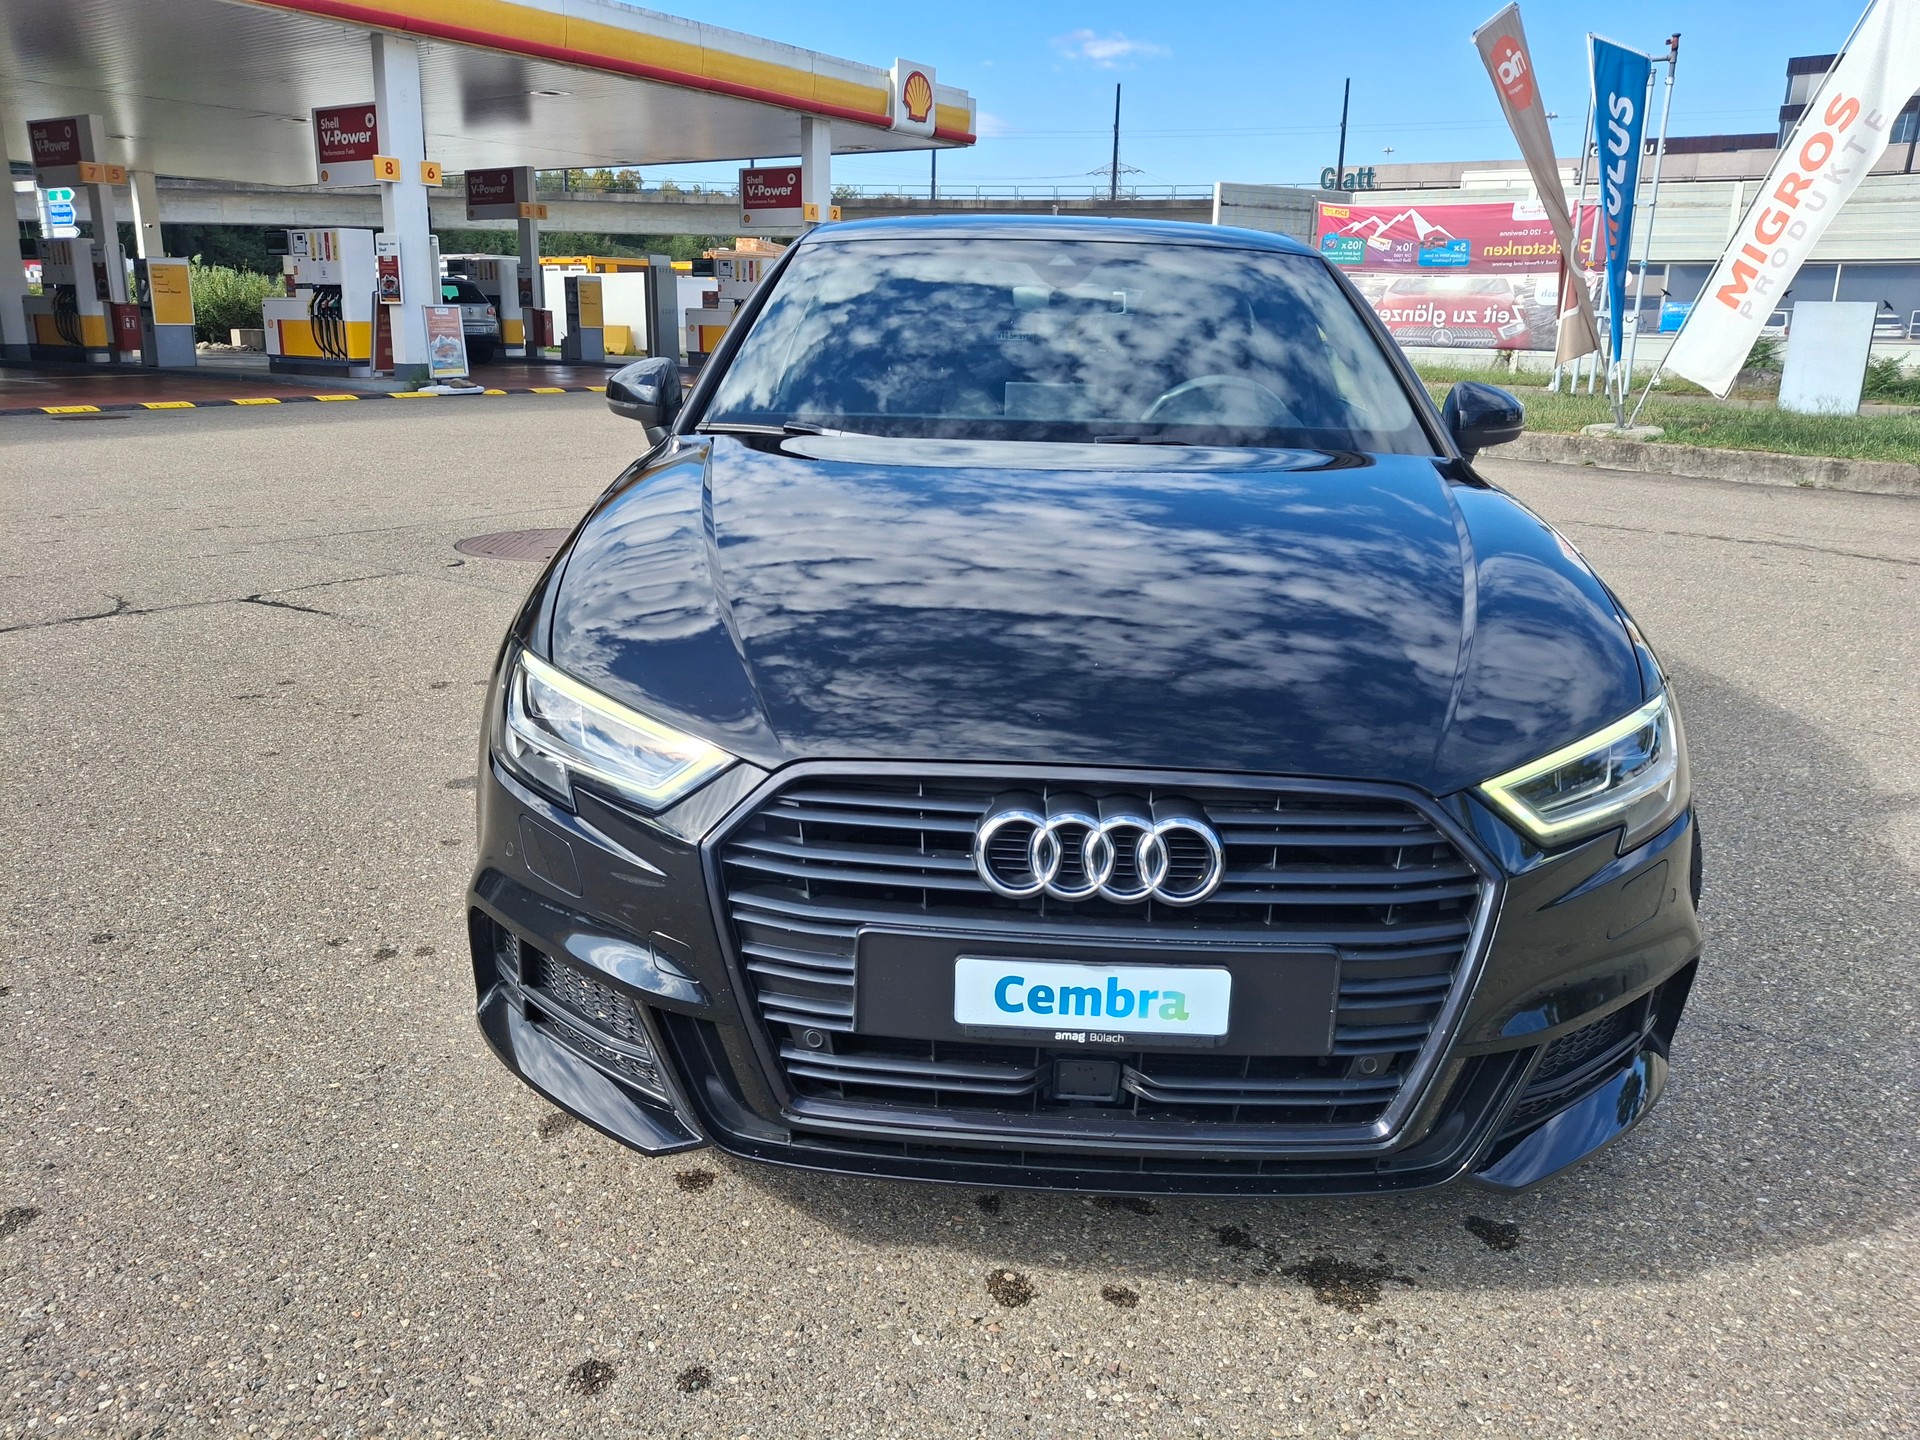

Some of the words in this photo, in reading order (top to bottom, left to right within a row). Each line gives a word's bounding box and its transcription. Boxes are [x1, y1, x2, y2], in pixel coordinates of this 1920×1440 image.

[320, 117, 339, 130] Shell
[33, 128, 47, 139] Shell
[321, 130, 372, 146] V-Power
[34, 139, 70, 153] V-Power
[87, 166, 96, 178] 7
[112, 168, 120, 180] 5
[385, 161, 394, 175] 8
[427, 167, 435, 179] 6
[746, 174, 764, 185] Shell
[1320, 166, 1376, 190] Gatt
[471, 184, 505, 195] V-Power
[746, 184, 793, 197] V-Power
[1715, 92, 1861, 310] MIGROS
[525, 206, 531, 215] 3
[538, 207, 543, 216] 1
[809, 207, 815, 217] 4
[832, 209, 838, 220] 2
[1740, 108, 1889, 320] PRODUKTE
[994, 975, 1190, 1021] Cembra
[1055, 1031, 1086, 1043] amag
[1089, 1033, 1125, 1044] Bülach
